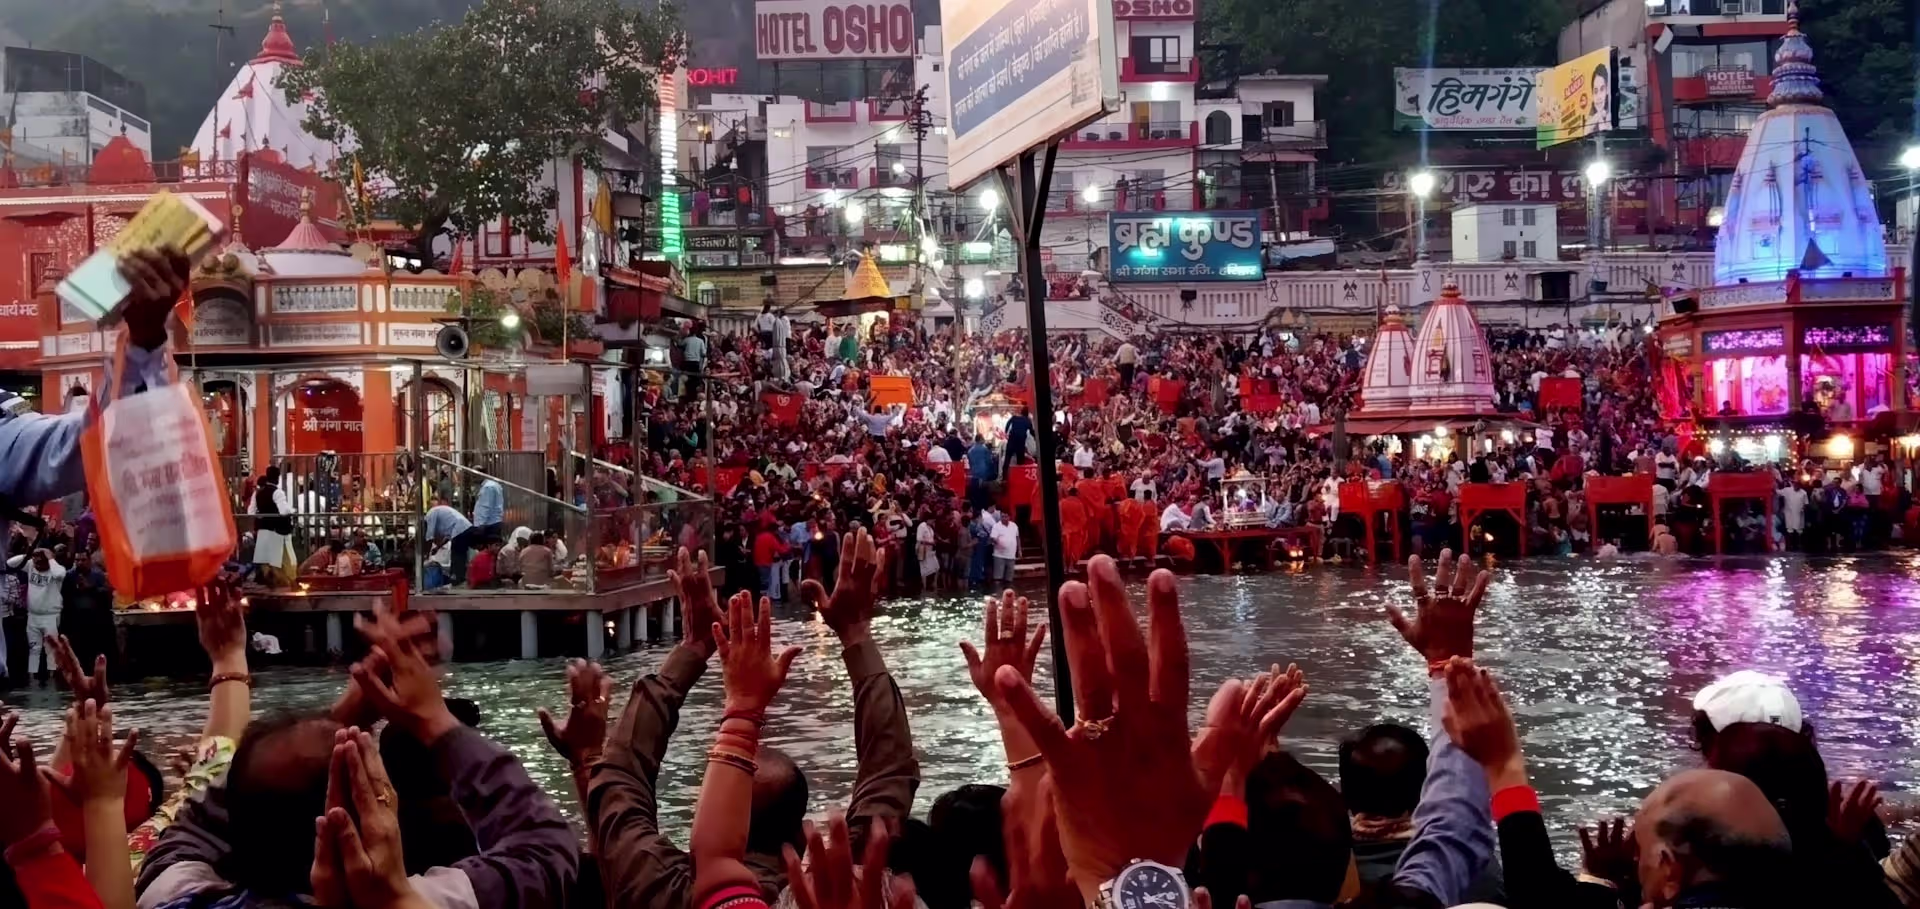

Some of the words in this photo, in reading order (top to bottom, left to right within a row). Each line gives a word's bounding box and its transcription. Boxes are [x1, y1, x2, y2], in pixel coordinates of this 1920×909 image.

[757, 12, 818, 55] HOTEL
[822, 3, 912, 55] OSHO
[685, 68, 738, 85] ROHIT
[1706, 71, 1754, 81] HOTEL
[1427, 77, 1537, 116] हिमगंगे
[1503, 170, 1553, 199] का
[1113, 217, 1174, 257] ब्रह्म
[1175, 217, 1257, 261] कुण्ड
[1115, 264, 1130, 277] श्री
[1132, 264, 1159, 276] गंगा
[1161, 266, 1186, 276] सभा
[302, 416, 319, 432] श्री
[319, 418, 341, 432] गंगा
[342, 420, 364, 432] मात
[936, 463, 952, 477] 29
[1024, 468, 1038, 481] 28
